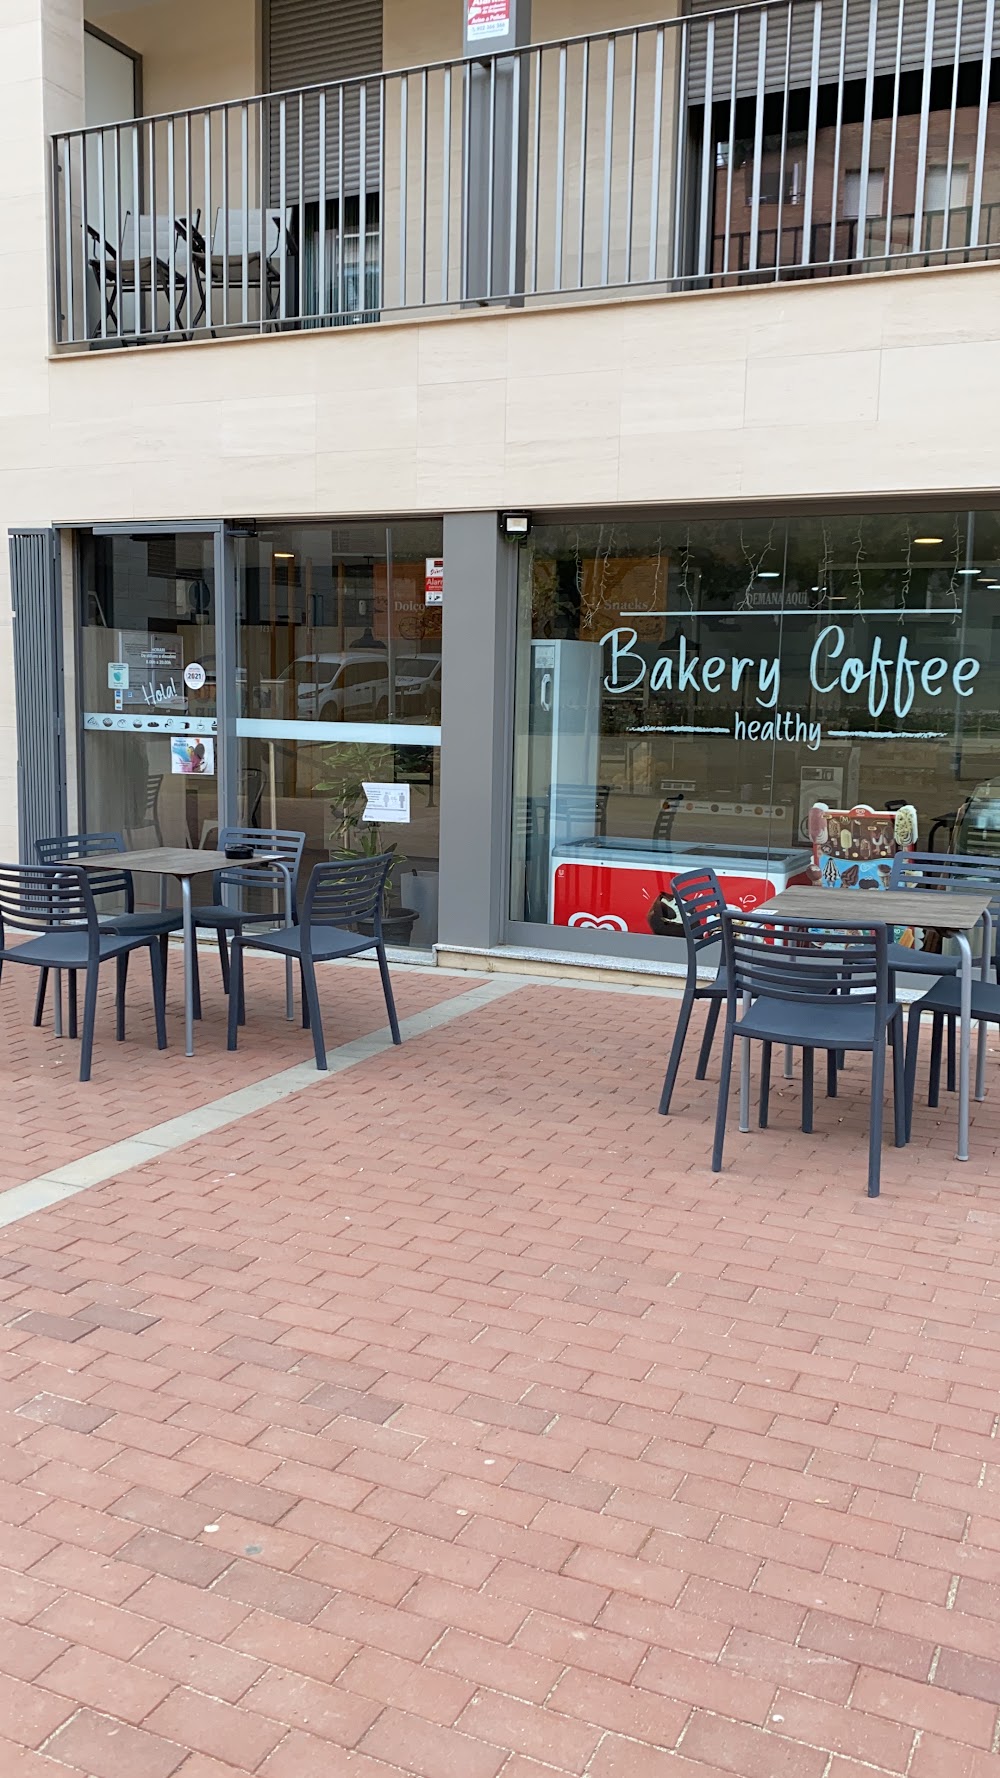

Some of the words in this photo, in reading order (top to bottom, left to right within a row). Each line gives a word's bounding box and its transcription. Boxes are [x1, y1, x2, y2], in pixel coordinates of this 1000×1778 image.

[604, 598, 648, 610] Snacks
[785, 589, 808, 606] AQUÍ
[187, 672, 202, 680] 2021
[599, 628, 780, 708] Bakery
[809, 626, 980, 718] Coffee
[142, 677, 178, 706] Hola!
[734, 711, 821, 751] healthy
